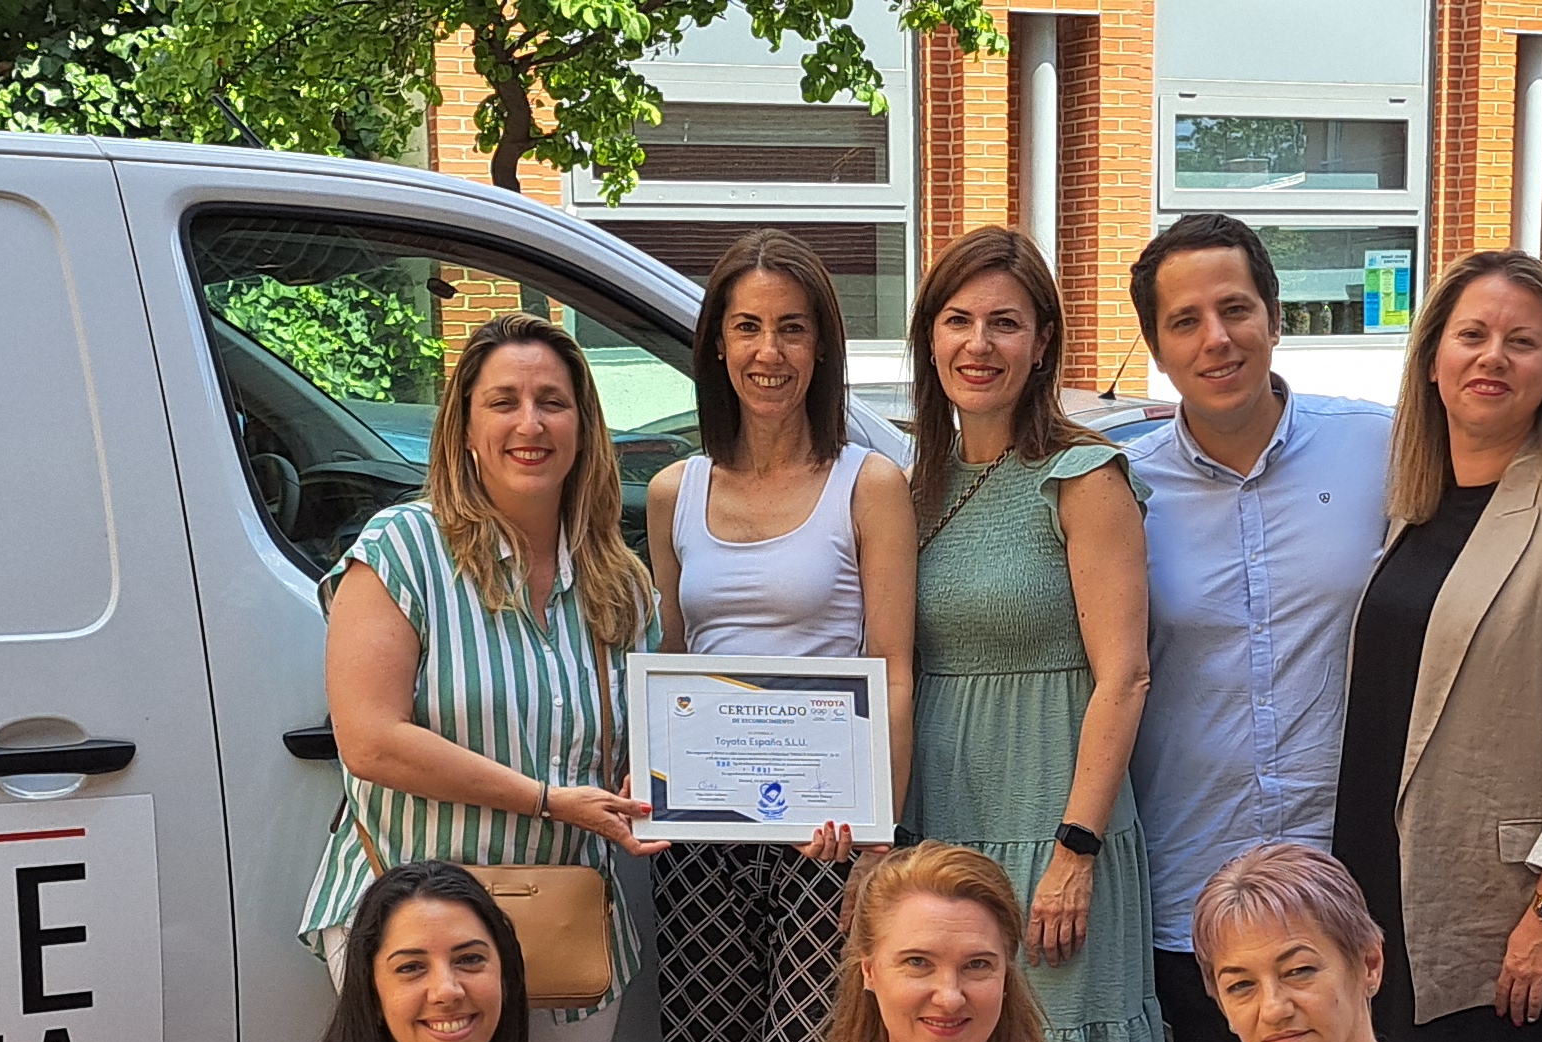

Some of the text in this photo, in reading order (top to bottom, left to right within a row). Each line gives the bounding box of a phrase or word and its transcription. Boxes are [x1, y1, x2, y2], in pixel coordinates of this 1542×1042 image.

[810, 699, 845, 708] TOYOTA
[718, 704, 807, 717] CERTIFICADO
[715, 736, 747, 748] Toyota
[749, 737, 783, 748] España
